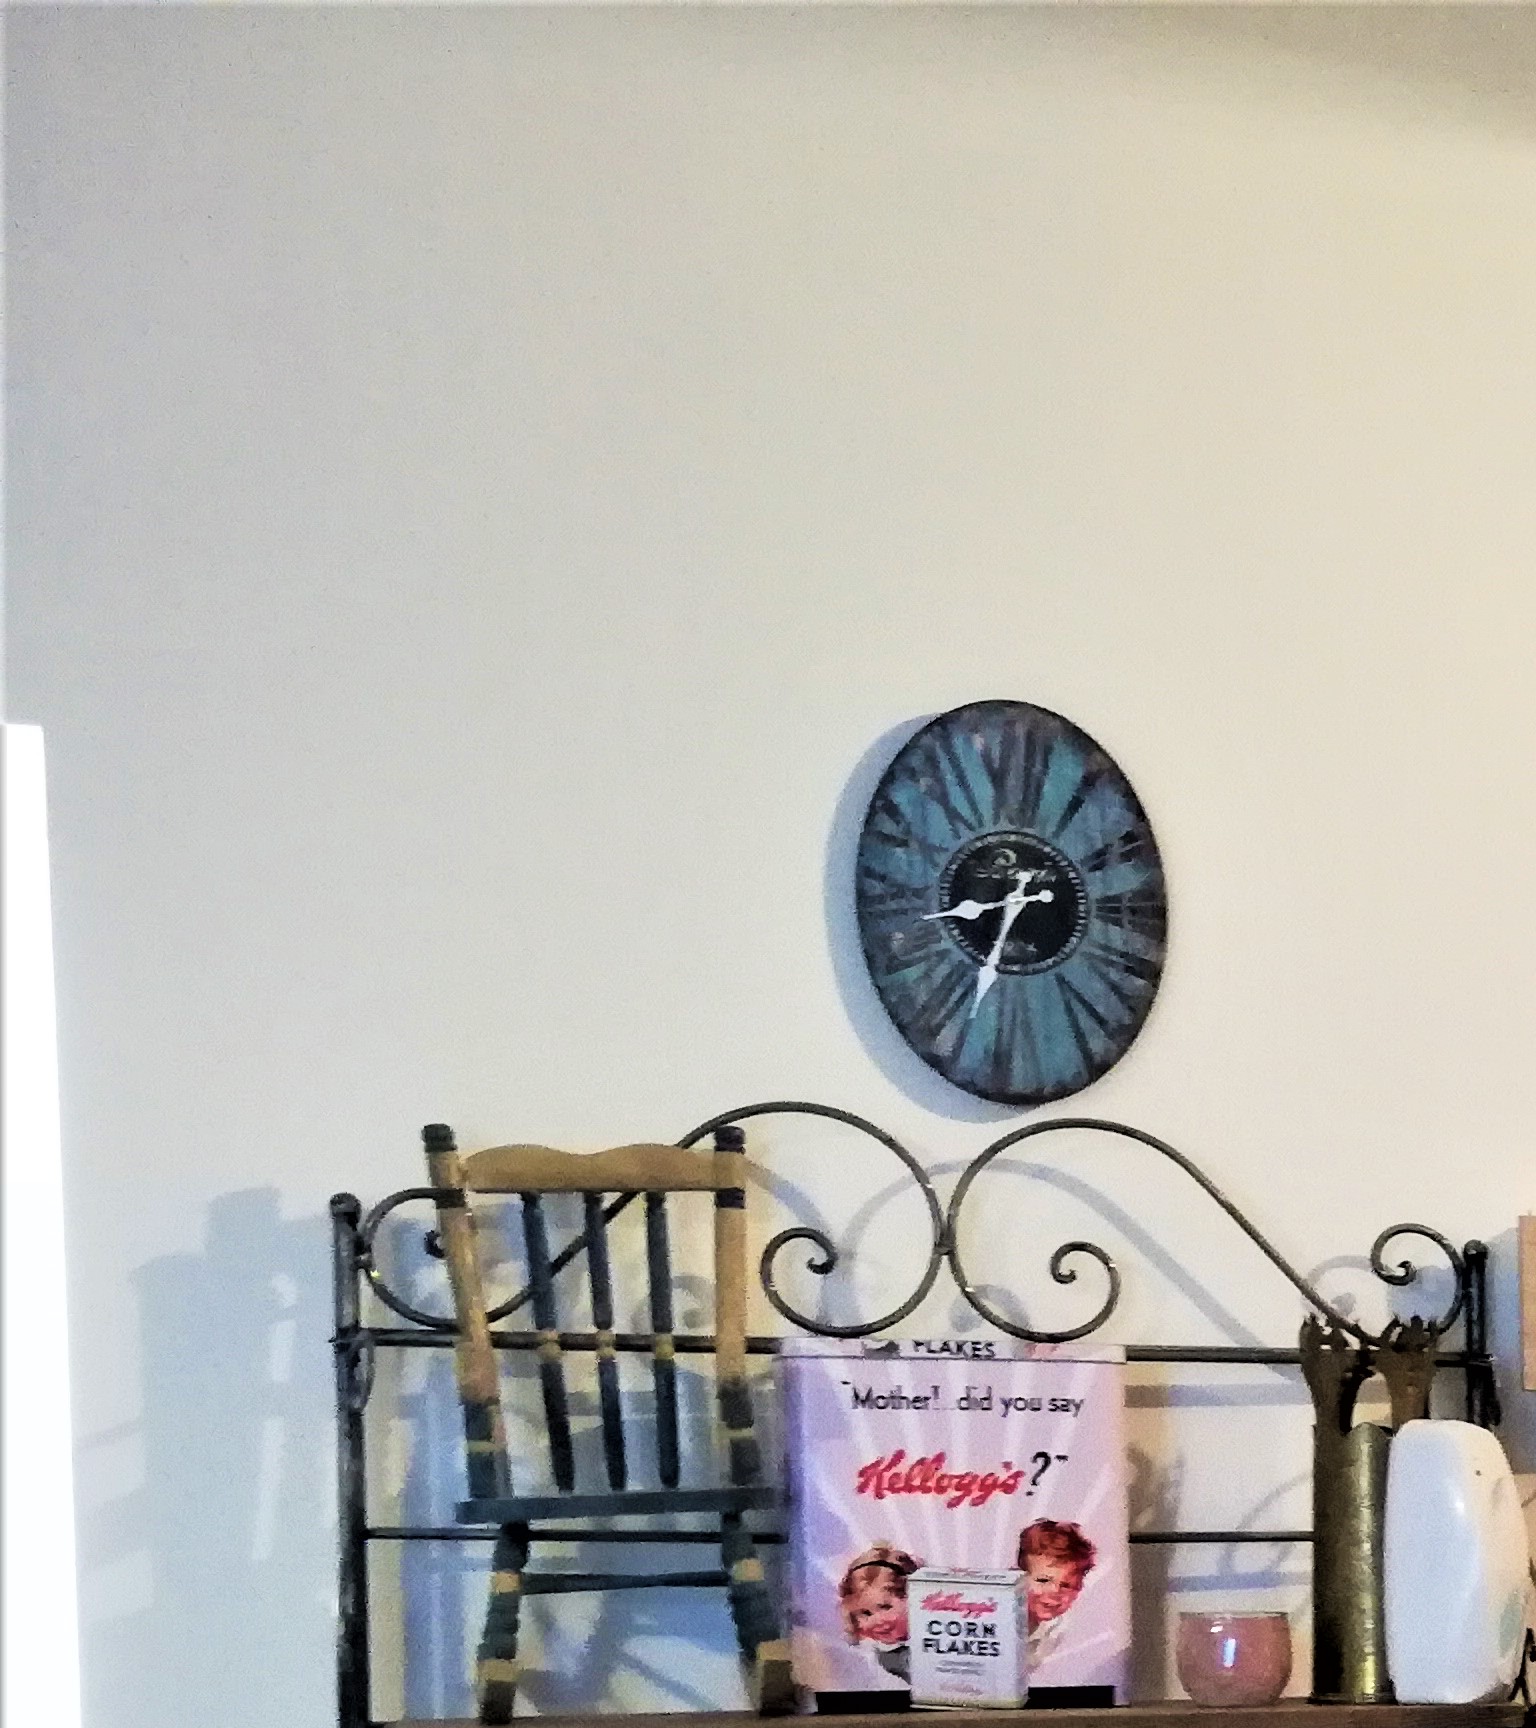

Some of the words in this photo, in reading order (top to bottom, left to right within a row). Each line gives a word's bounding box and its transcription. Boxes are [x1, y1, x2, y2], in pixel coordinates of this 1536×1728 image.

[913, 1341, 996, 1359] FLAKES
[1000, 1396, 1044, 1418] you
[1048, 1398, 1086, 1418] say
[927, 1620, 998, 1638] CORN
[922, 1637, 1001, 1657] FLAKES
